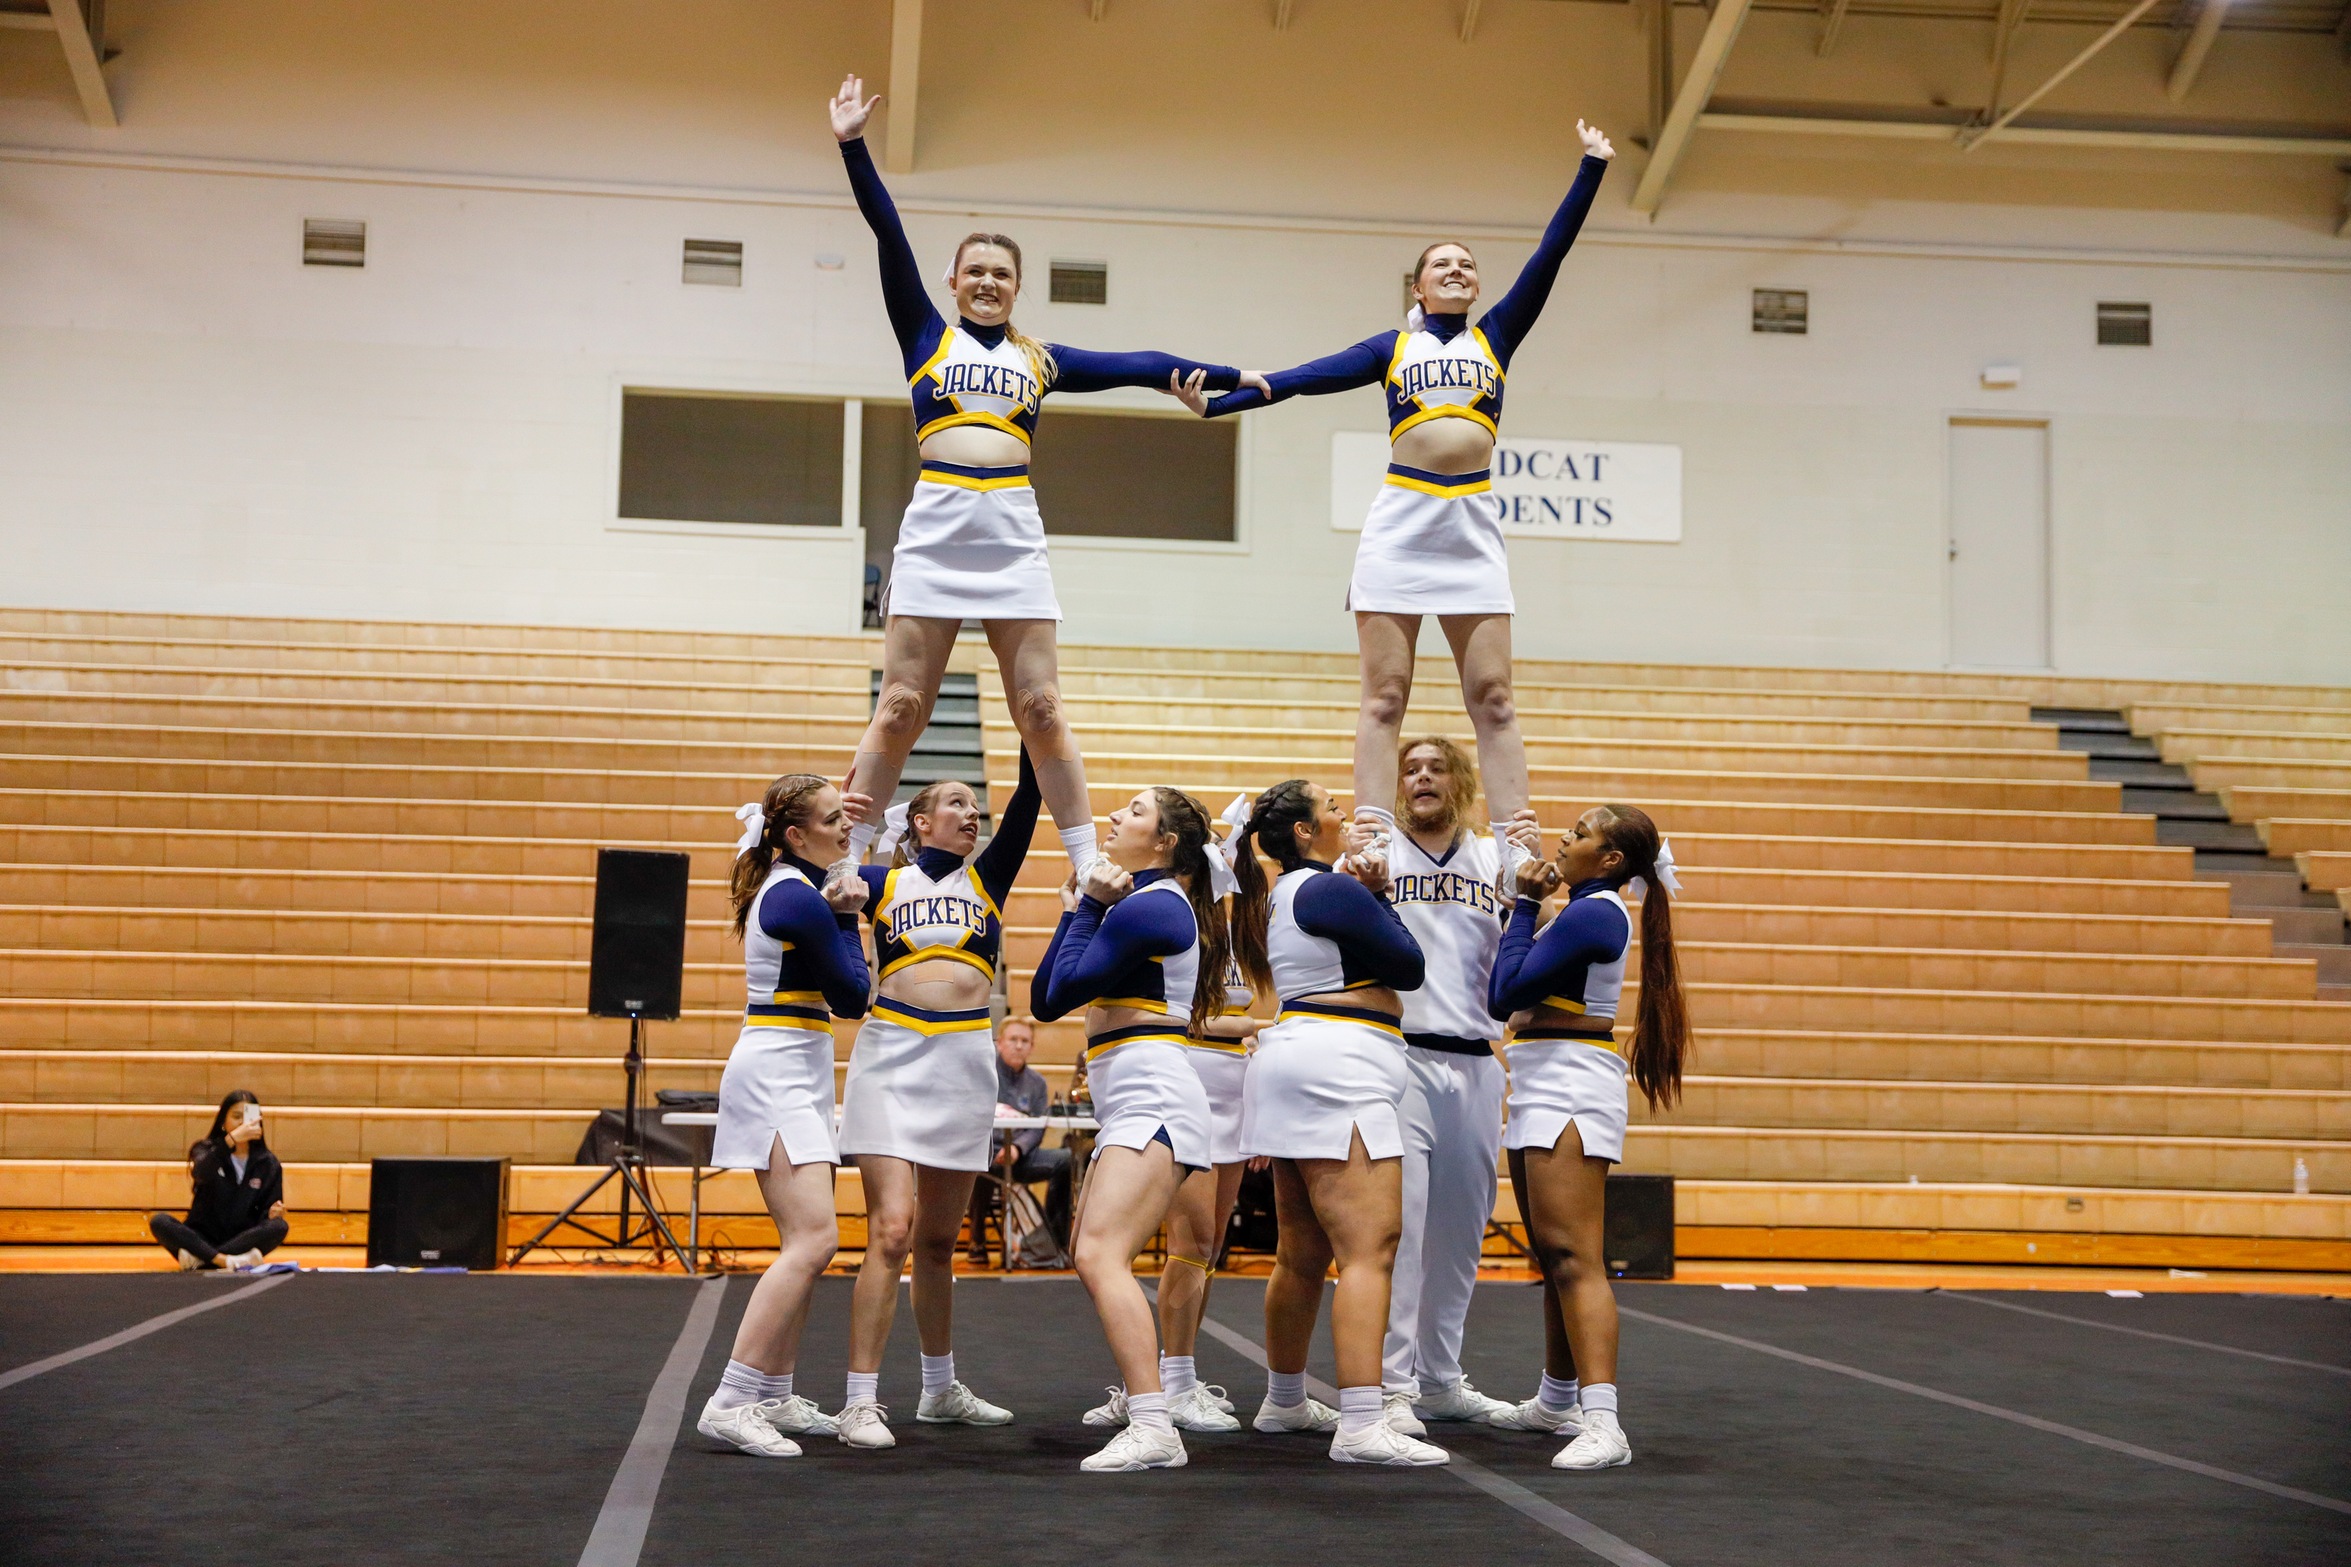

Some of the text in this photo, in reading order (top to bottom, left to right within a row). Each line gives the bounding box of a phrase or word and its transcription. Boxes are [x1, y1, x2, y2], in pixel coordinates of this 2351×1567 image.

[934, 363, 1037, 414] JACKETS
[1398, 358, 1496, 402] JACKETS
[1491, 449, 1610, 481] DCAT
[1391, 872, 1495, 915] JACKETS
[887, 896, 986, 942] JACKETS
